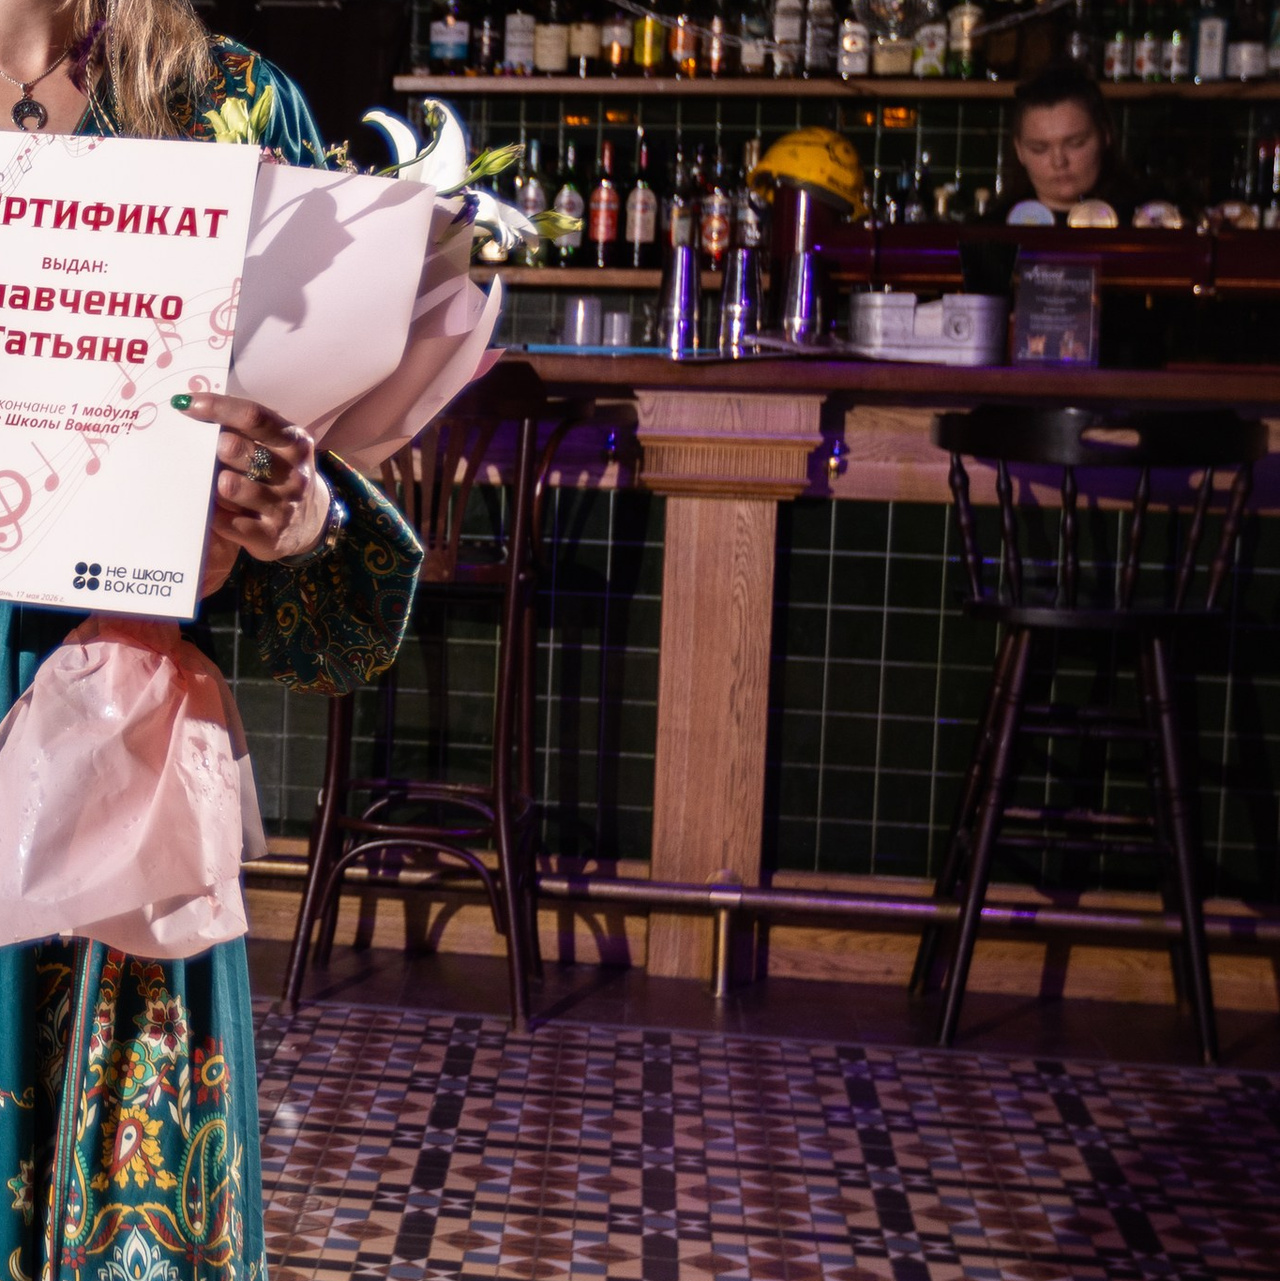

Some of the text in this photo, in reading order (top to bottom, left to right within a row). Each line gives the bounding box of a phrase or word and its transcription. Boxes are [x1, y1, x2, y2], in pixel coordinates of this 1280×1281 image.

[41, 256, 109, 275] ВЫДАН:
[70, 402, 79, 416] 1
[81, 404, 141, 421] модуля
[5, 412, 61, 430] Школы
[16, 590, 25, 598] 17
